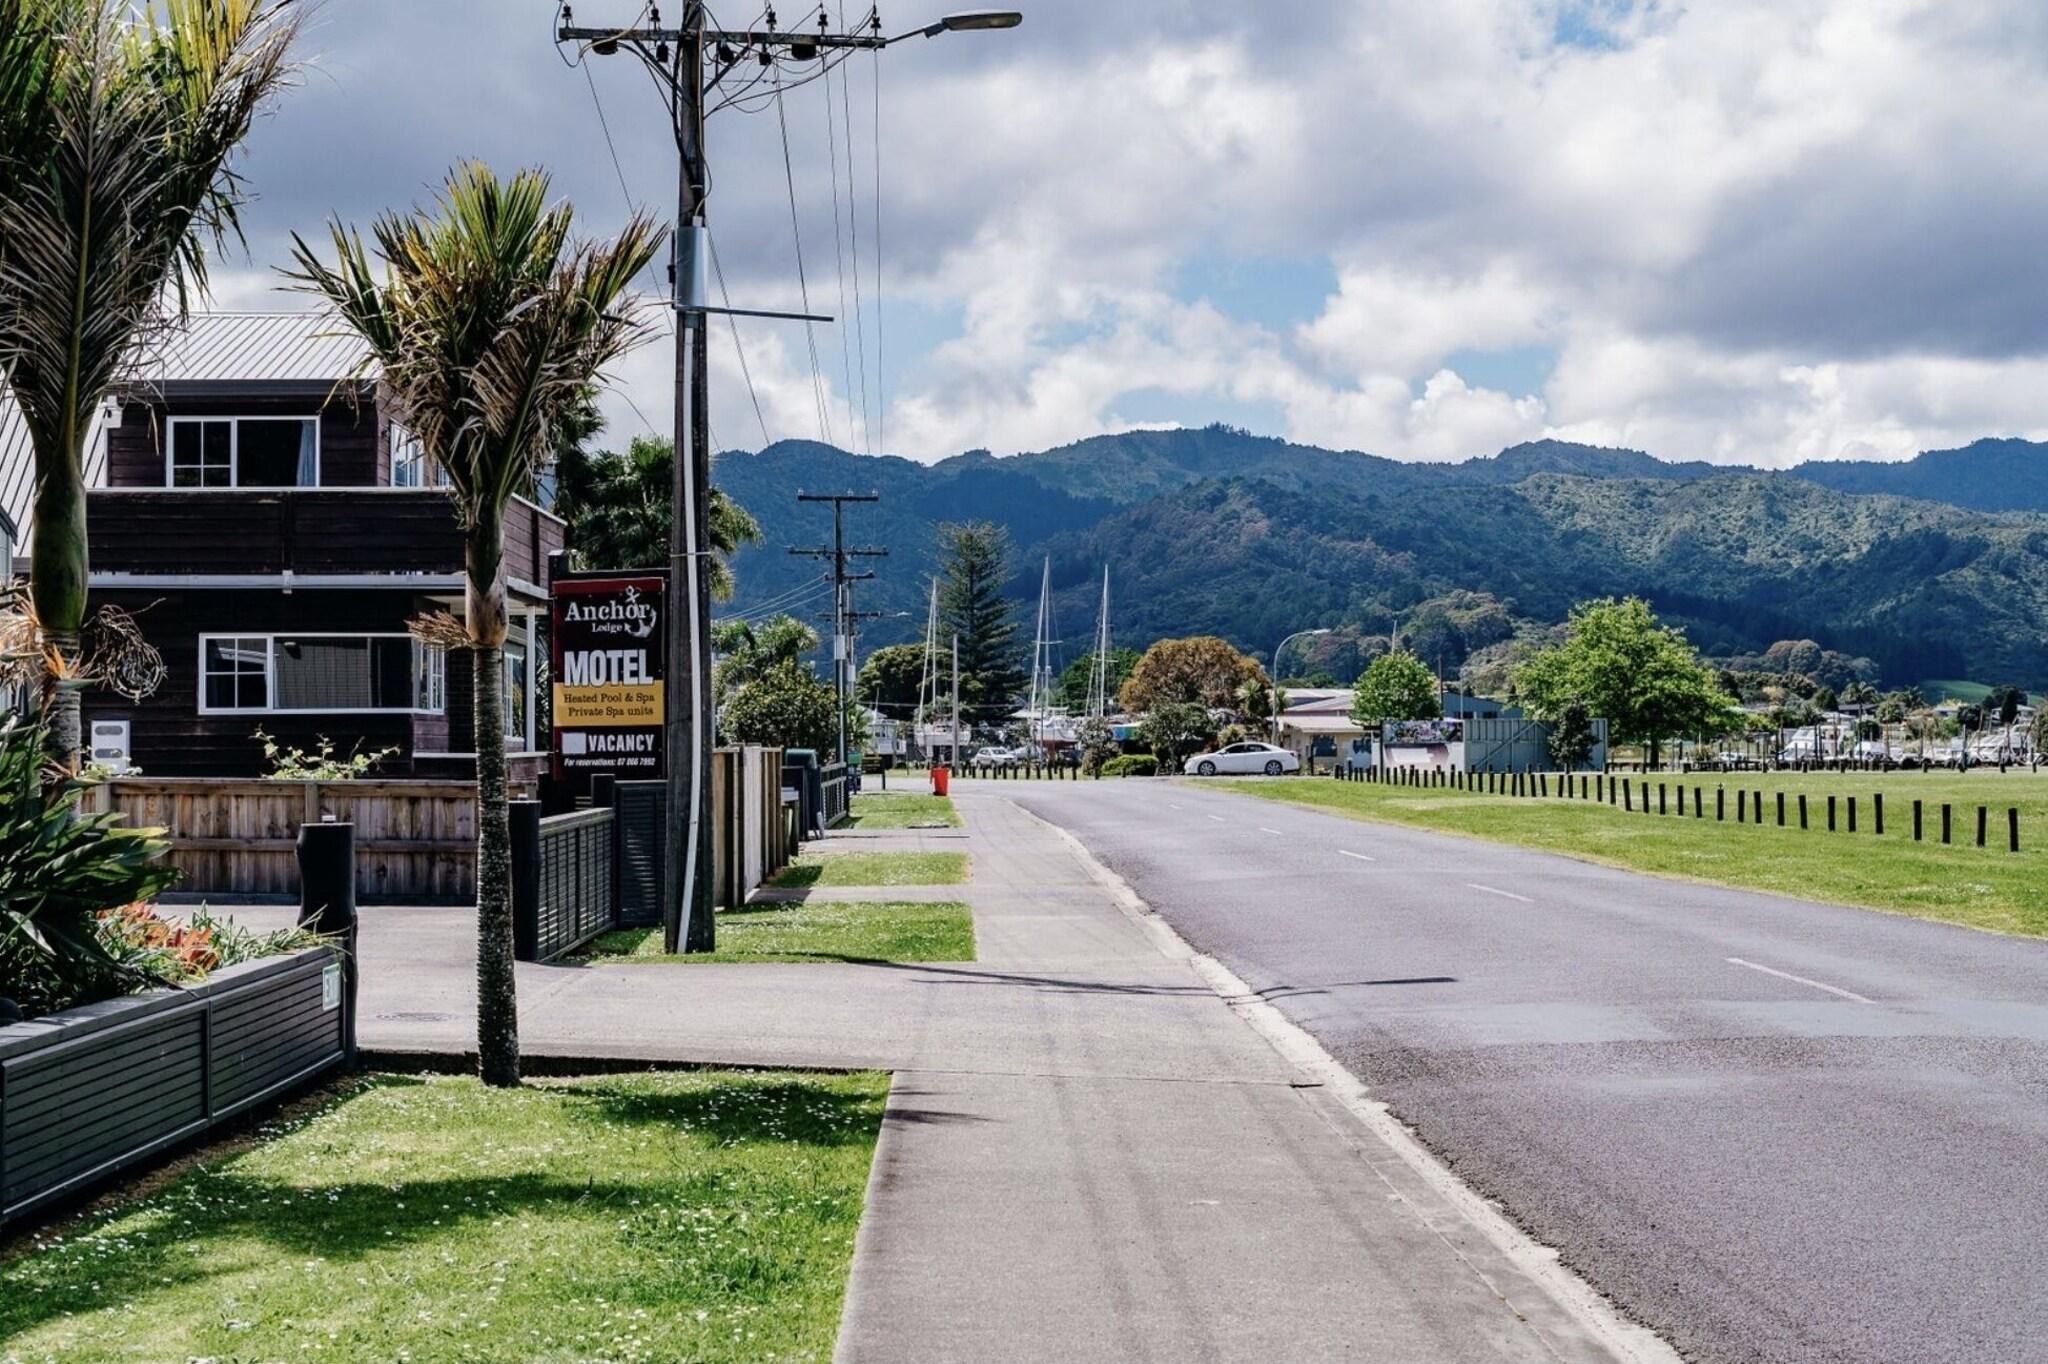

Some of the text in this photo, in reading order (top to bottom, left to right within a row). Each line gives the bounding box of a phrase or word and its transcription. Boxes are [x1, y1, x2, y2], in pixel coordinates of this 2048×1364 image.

[564, 600, 651, 621] Anchor
[591, 622, 623, 633] Lodge
[564, 649, 654, 687] MOTEL
[563, 692, 656, 704] Heated Pool & Spa
[568, 706, 654, 718] Private Spa units
[588, 733, 655, 752] VACANCY
[563, 758, 575, 767] For
